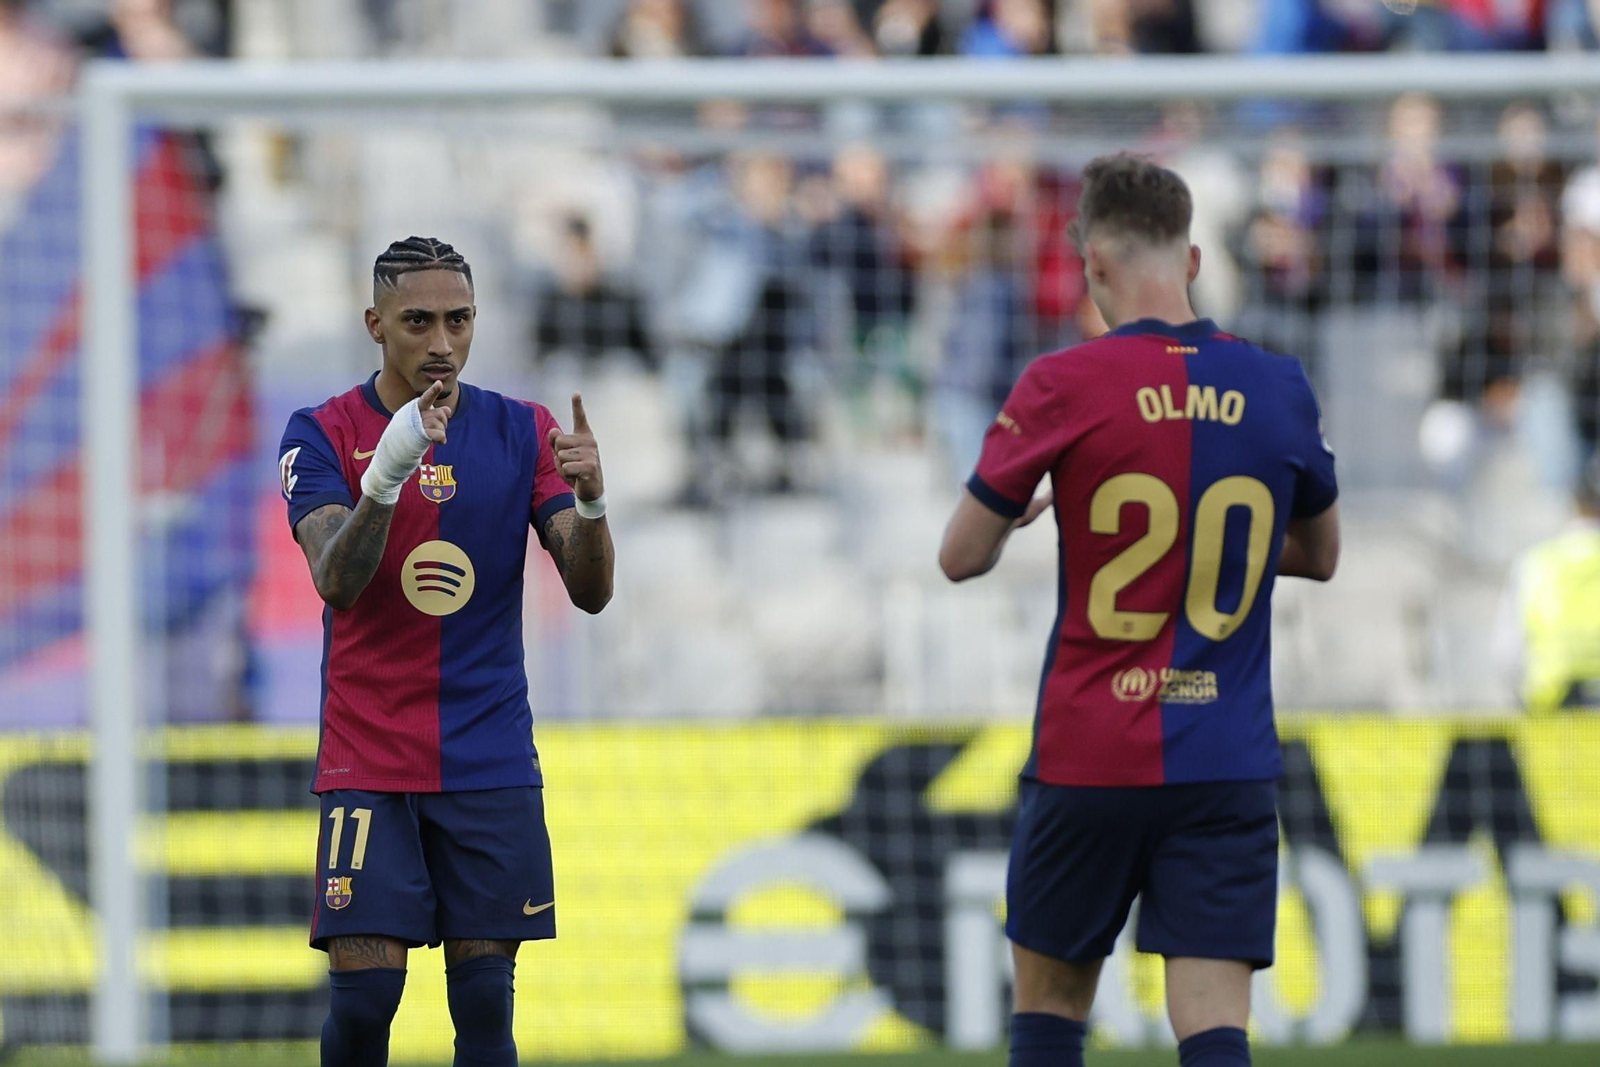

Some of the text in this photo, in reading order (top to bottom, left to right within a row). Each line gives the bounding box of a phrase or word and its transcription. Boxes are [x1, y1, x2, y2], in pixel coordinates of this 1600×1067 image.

[1136, 384, 1245, 426] OLMO
[1087, 472, 1275, 641] 20
[328, 807, 372, 870] 11
